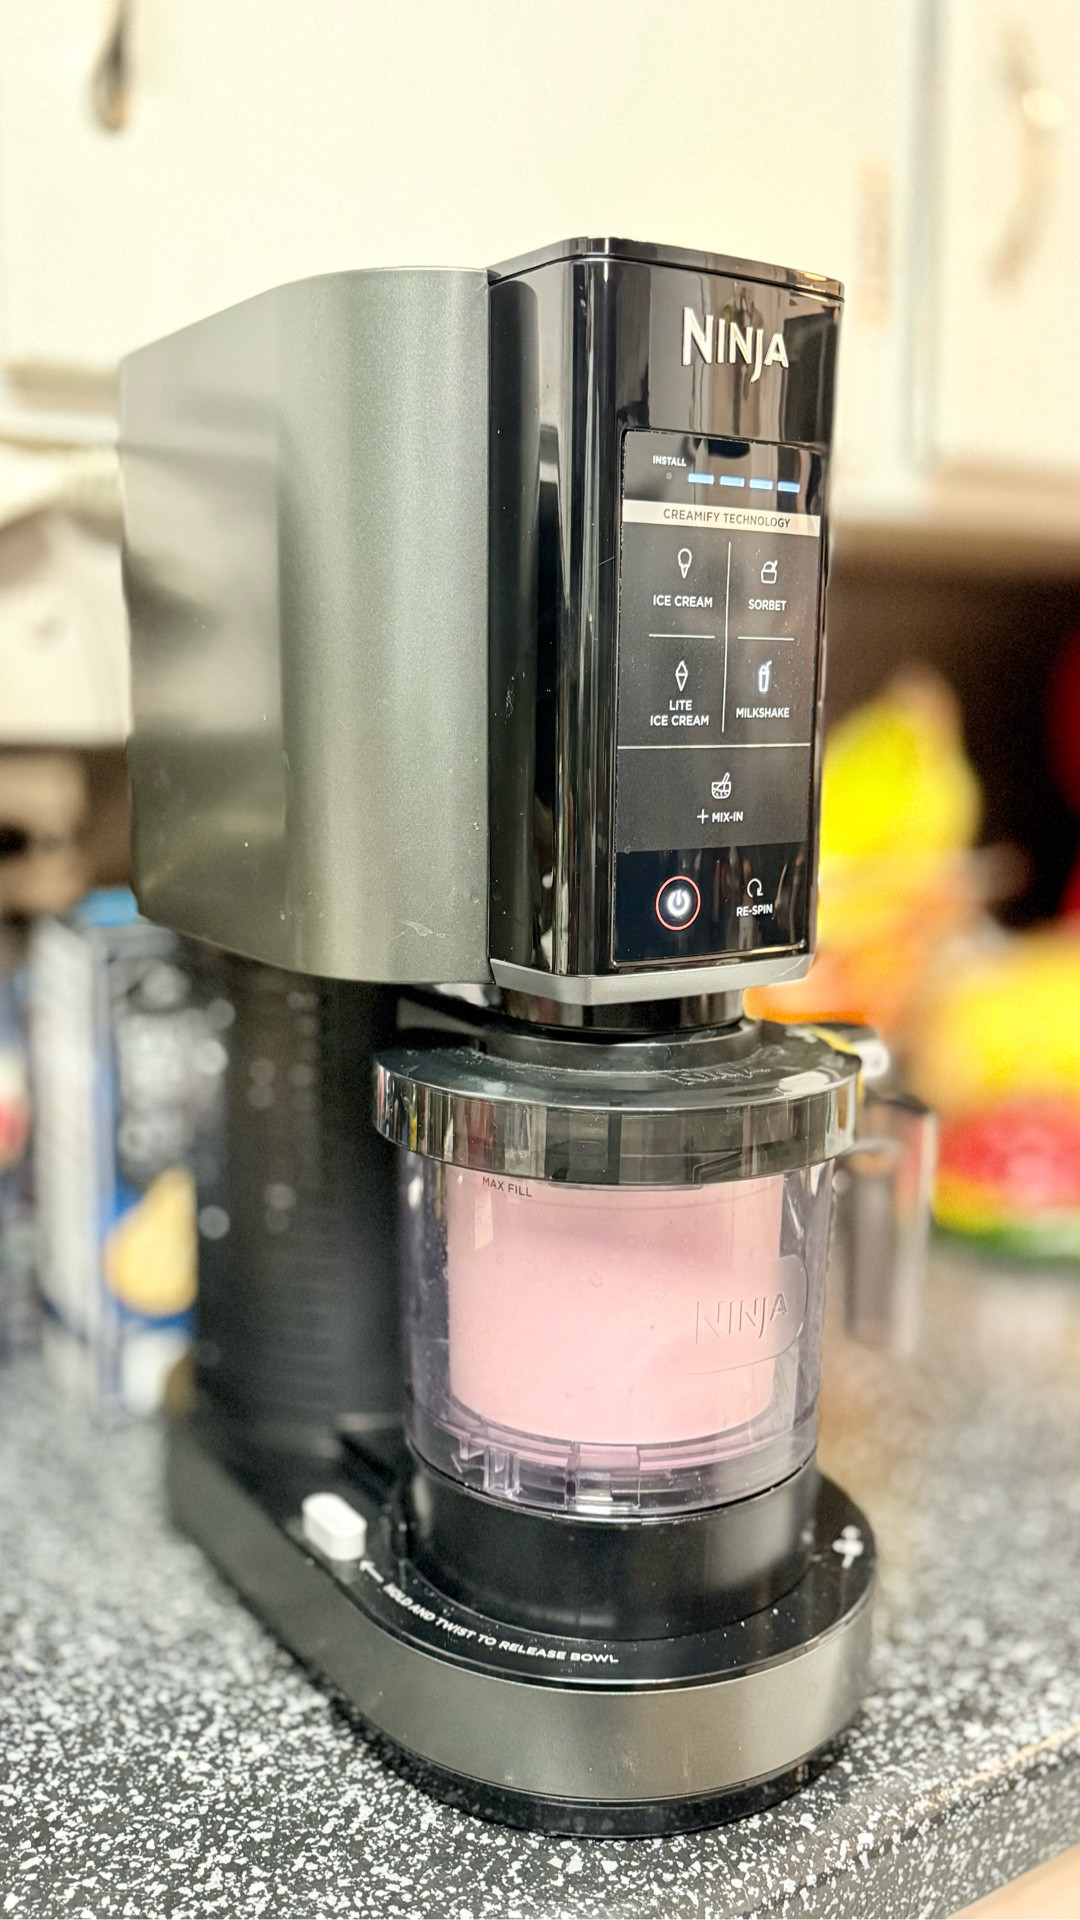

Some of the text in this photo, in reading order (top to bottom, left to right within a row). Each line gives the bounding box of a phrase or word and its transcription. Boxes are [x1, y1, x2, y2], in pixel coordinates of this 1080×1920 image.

[682, 306, 790, 384] NINJA
[652, 454, 688, 468] INSTALL
[662, 508, 792, 529] CREAMIFY TECHNOLOGY
[652, 594, 713, 609] ICE CREAM
[748, 598, 788, 612] SORBET
[669, 699, 693, 712] LITE
[735, 707, 791, 719] MILKSHAKE
[650, 714, 710, 727] ICE CREAM
[711, 811, 744, 823] MIX-IN
[736, 903, 773, 917] RE-SPIN
[482, 1175, 533, 1198] MAX FILL
[695, 1290, 789, 1346] NINJA
[407, 1603, 437, 1622] AND
[435, 1616, 477, 1640] TWIST
[478, 1634, 498, 1646] TO
[499, 1640, 567, 1661] RELEASE
[570, 1651, 620, 1664] BOWL
